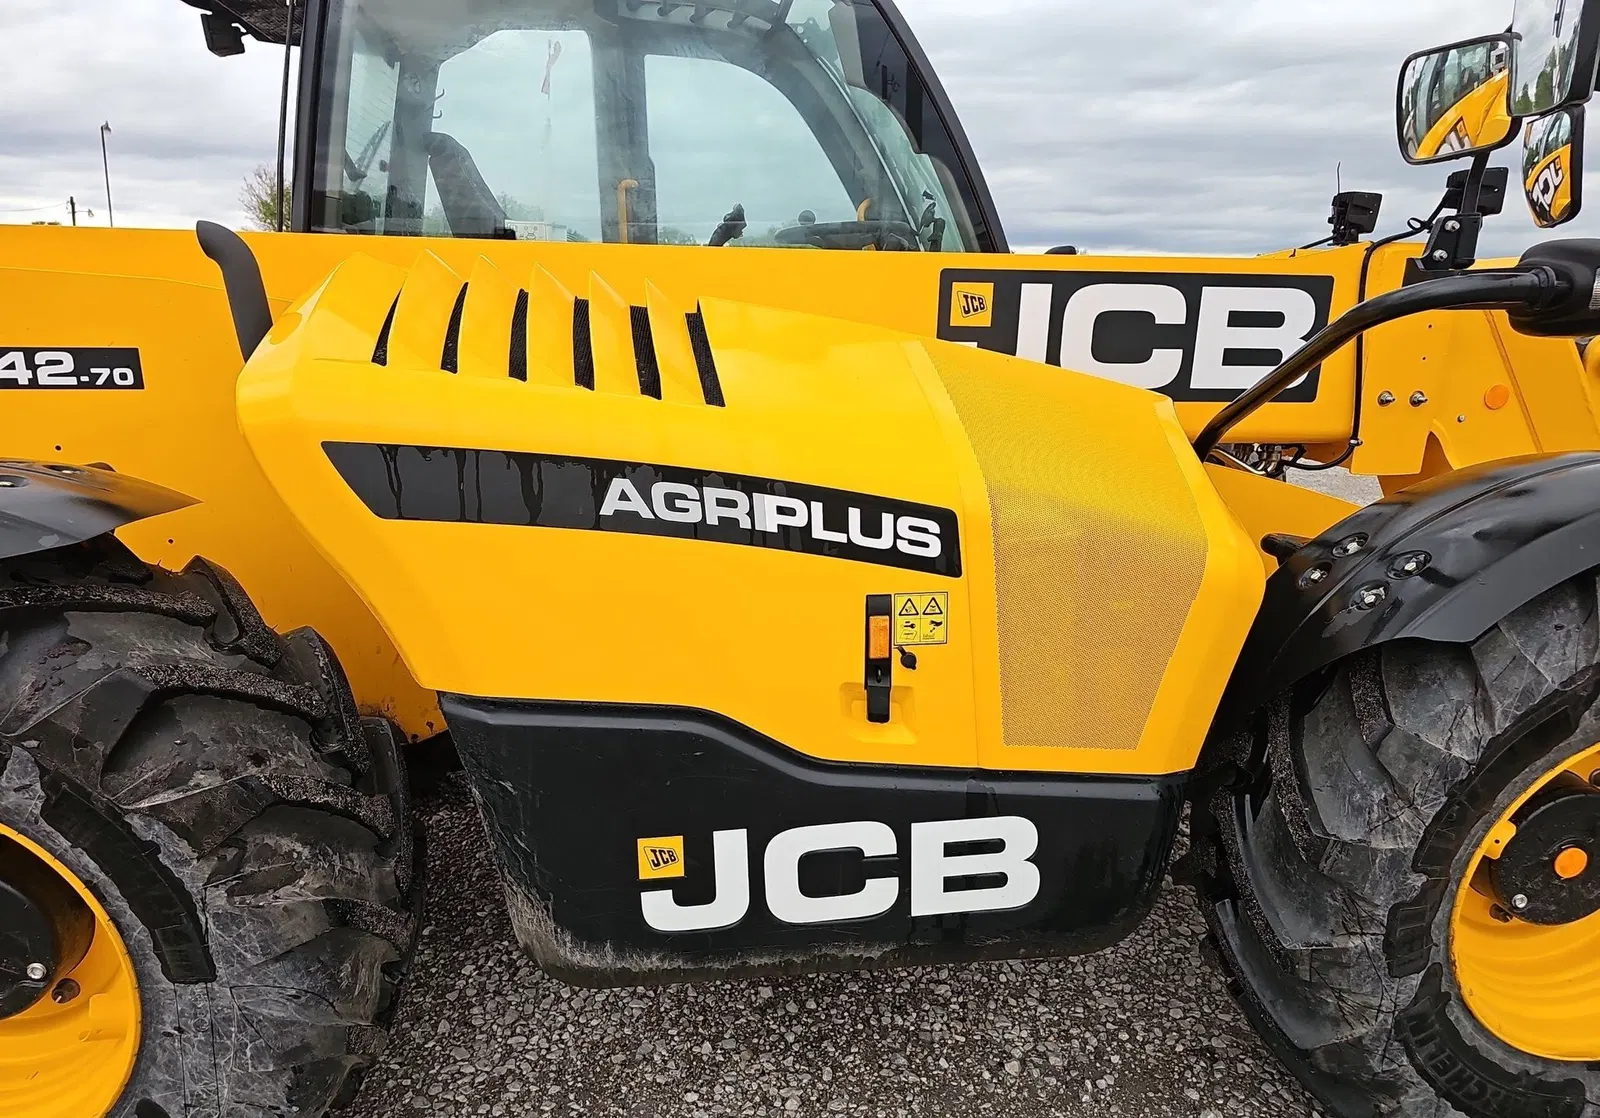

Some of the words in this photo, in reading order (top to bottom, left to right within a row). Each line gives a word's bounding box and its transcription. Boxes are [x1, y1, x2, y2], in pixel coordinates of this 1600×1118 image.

[963, 294, 986, 315] JCB
[599, 477, 943, 558] AGRIPLUS
[640, 815, 1041, 932] JCB
[650, 848, 677, 868] JCB
